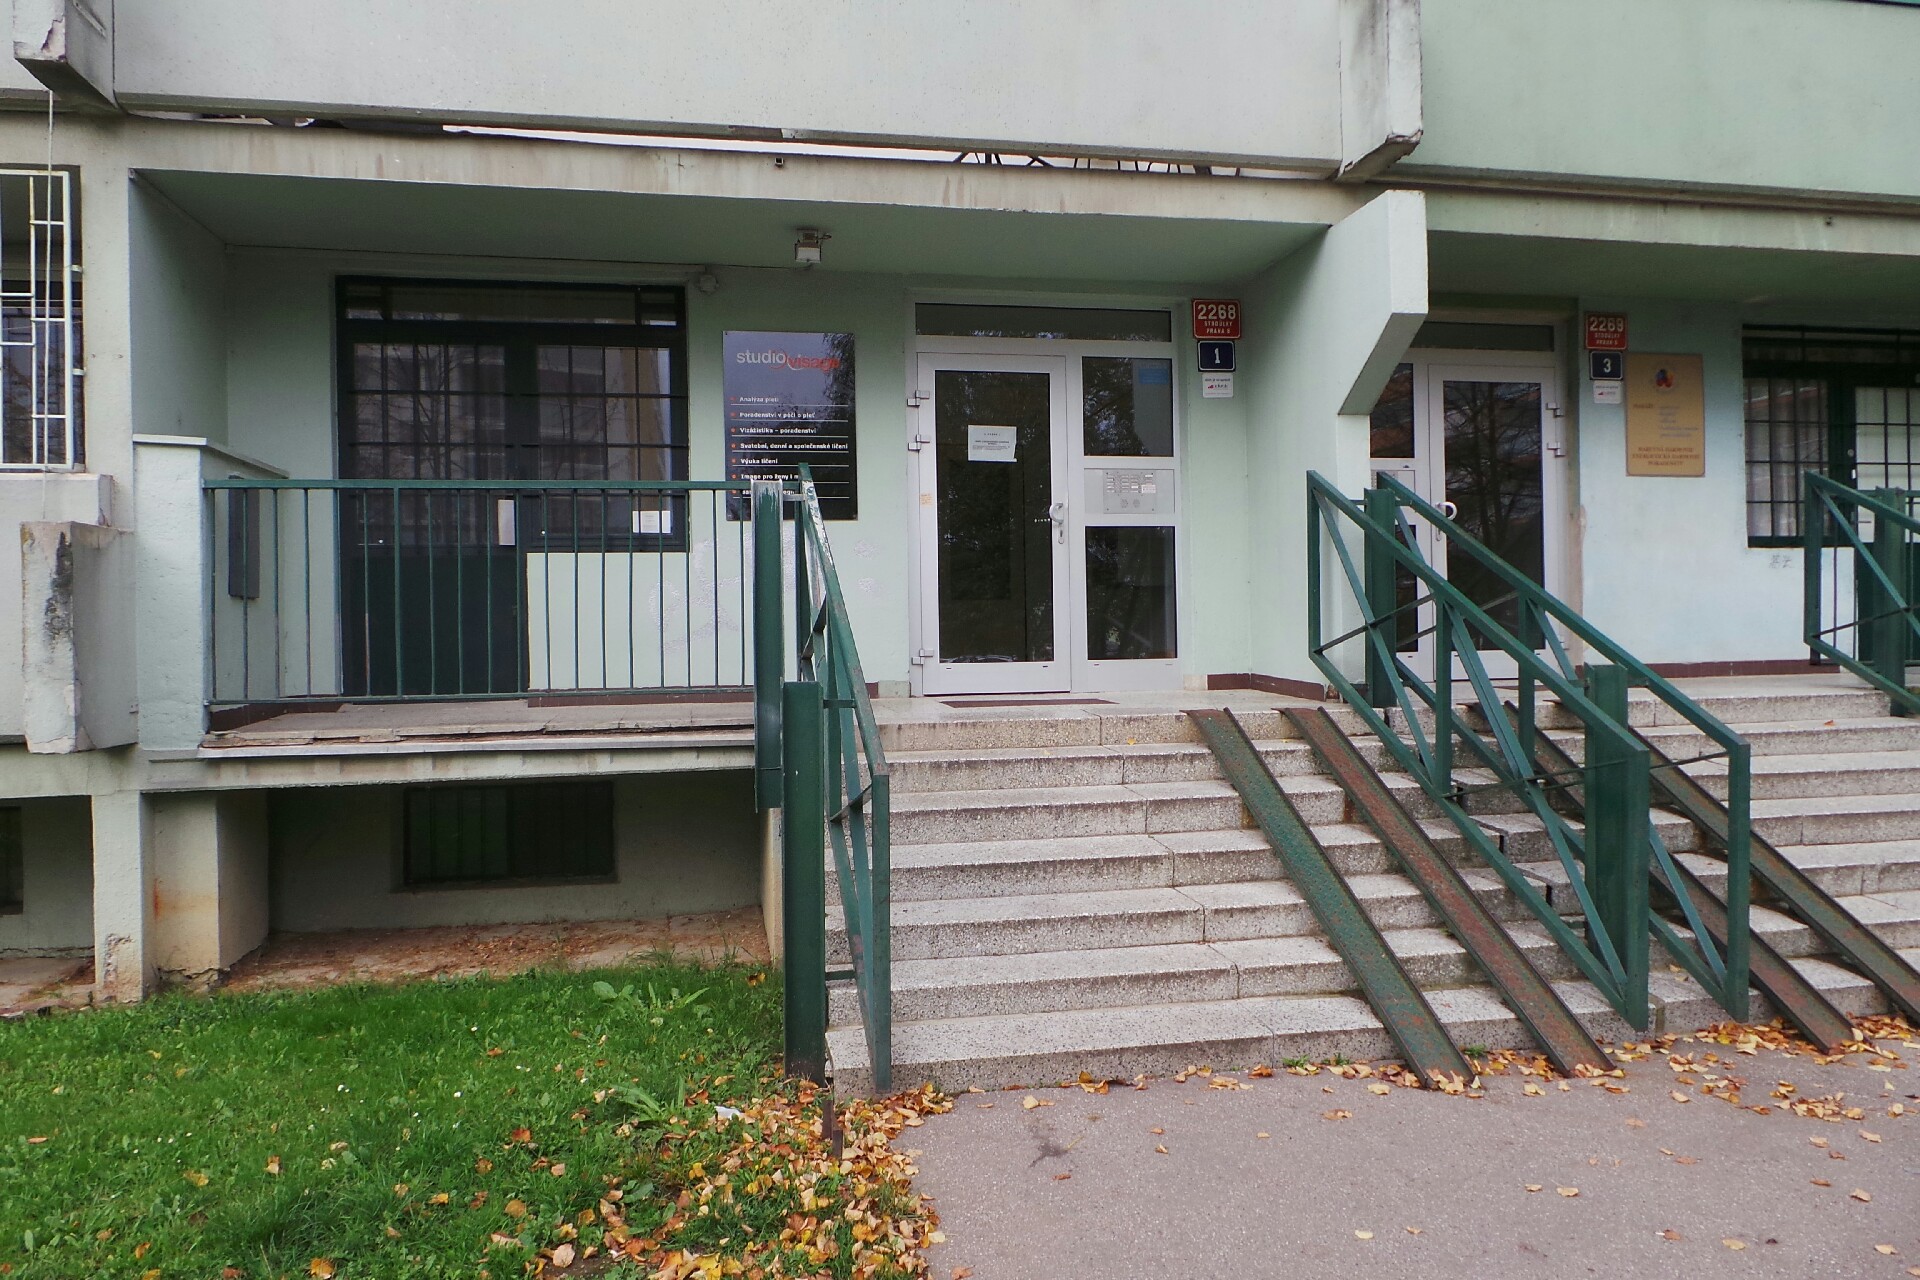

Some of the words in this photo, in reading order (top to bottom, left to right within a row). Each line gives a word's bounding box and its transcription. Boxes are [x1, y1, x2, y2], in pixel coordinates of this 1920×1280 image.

[1198, 304, 1236, 319] 2268
[1589, 316, 1624, 332] 2269
[736, 349, 786, 364] studio
[787, 354, 841, 373] visage
[1214, 347, 1221, 364] 1
[1603, 358, 1611, 373] 3
